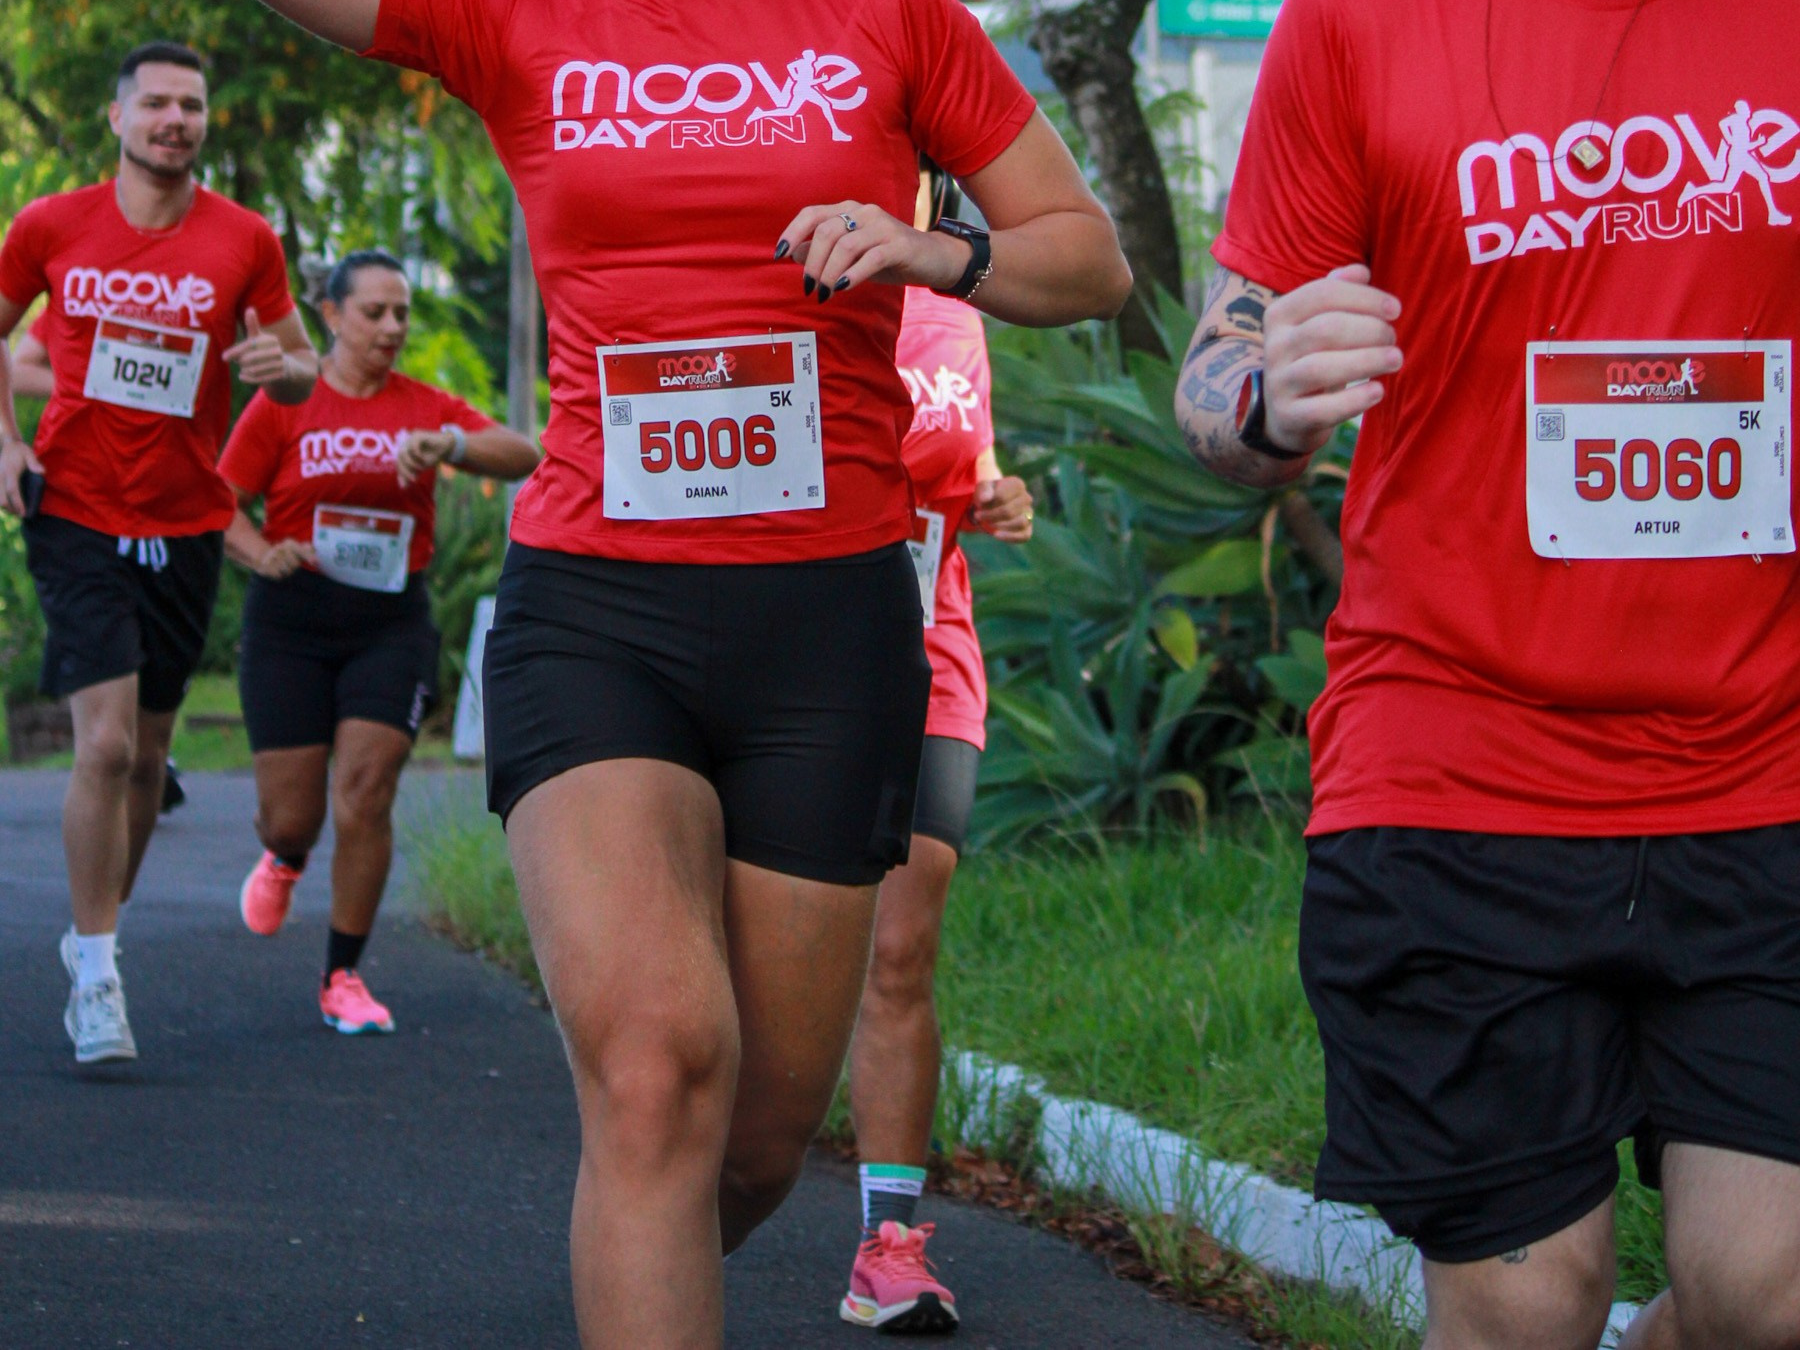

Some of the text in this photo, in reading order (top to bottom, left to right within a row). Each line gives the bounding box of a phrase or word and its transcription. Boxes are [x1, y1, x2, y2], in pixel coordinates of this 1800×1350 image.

[113, 355, 172, 390] 1024
[770, 390, 792, 408] 5K
[1739, 410, 1761, 430] 5K
[639, 414, 776, 474] 5006
[1574, 438, 1742, 502] 5060
[685, 486, 728, 500] DAIANA
[1634, 521, 1680, 535] ARTUR
